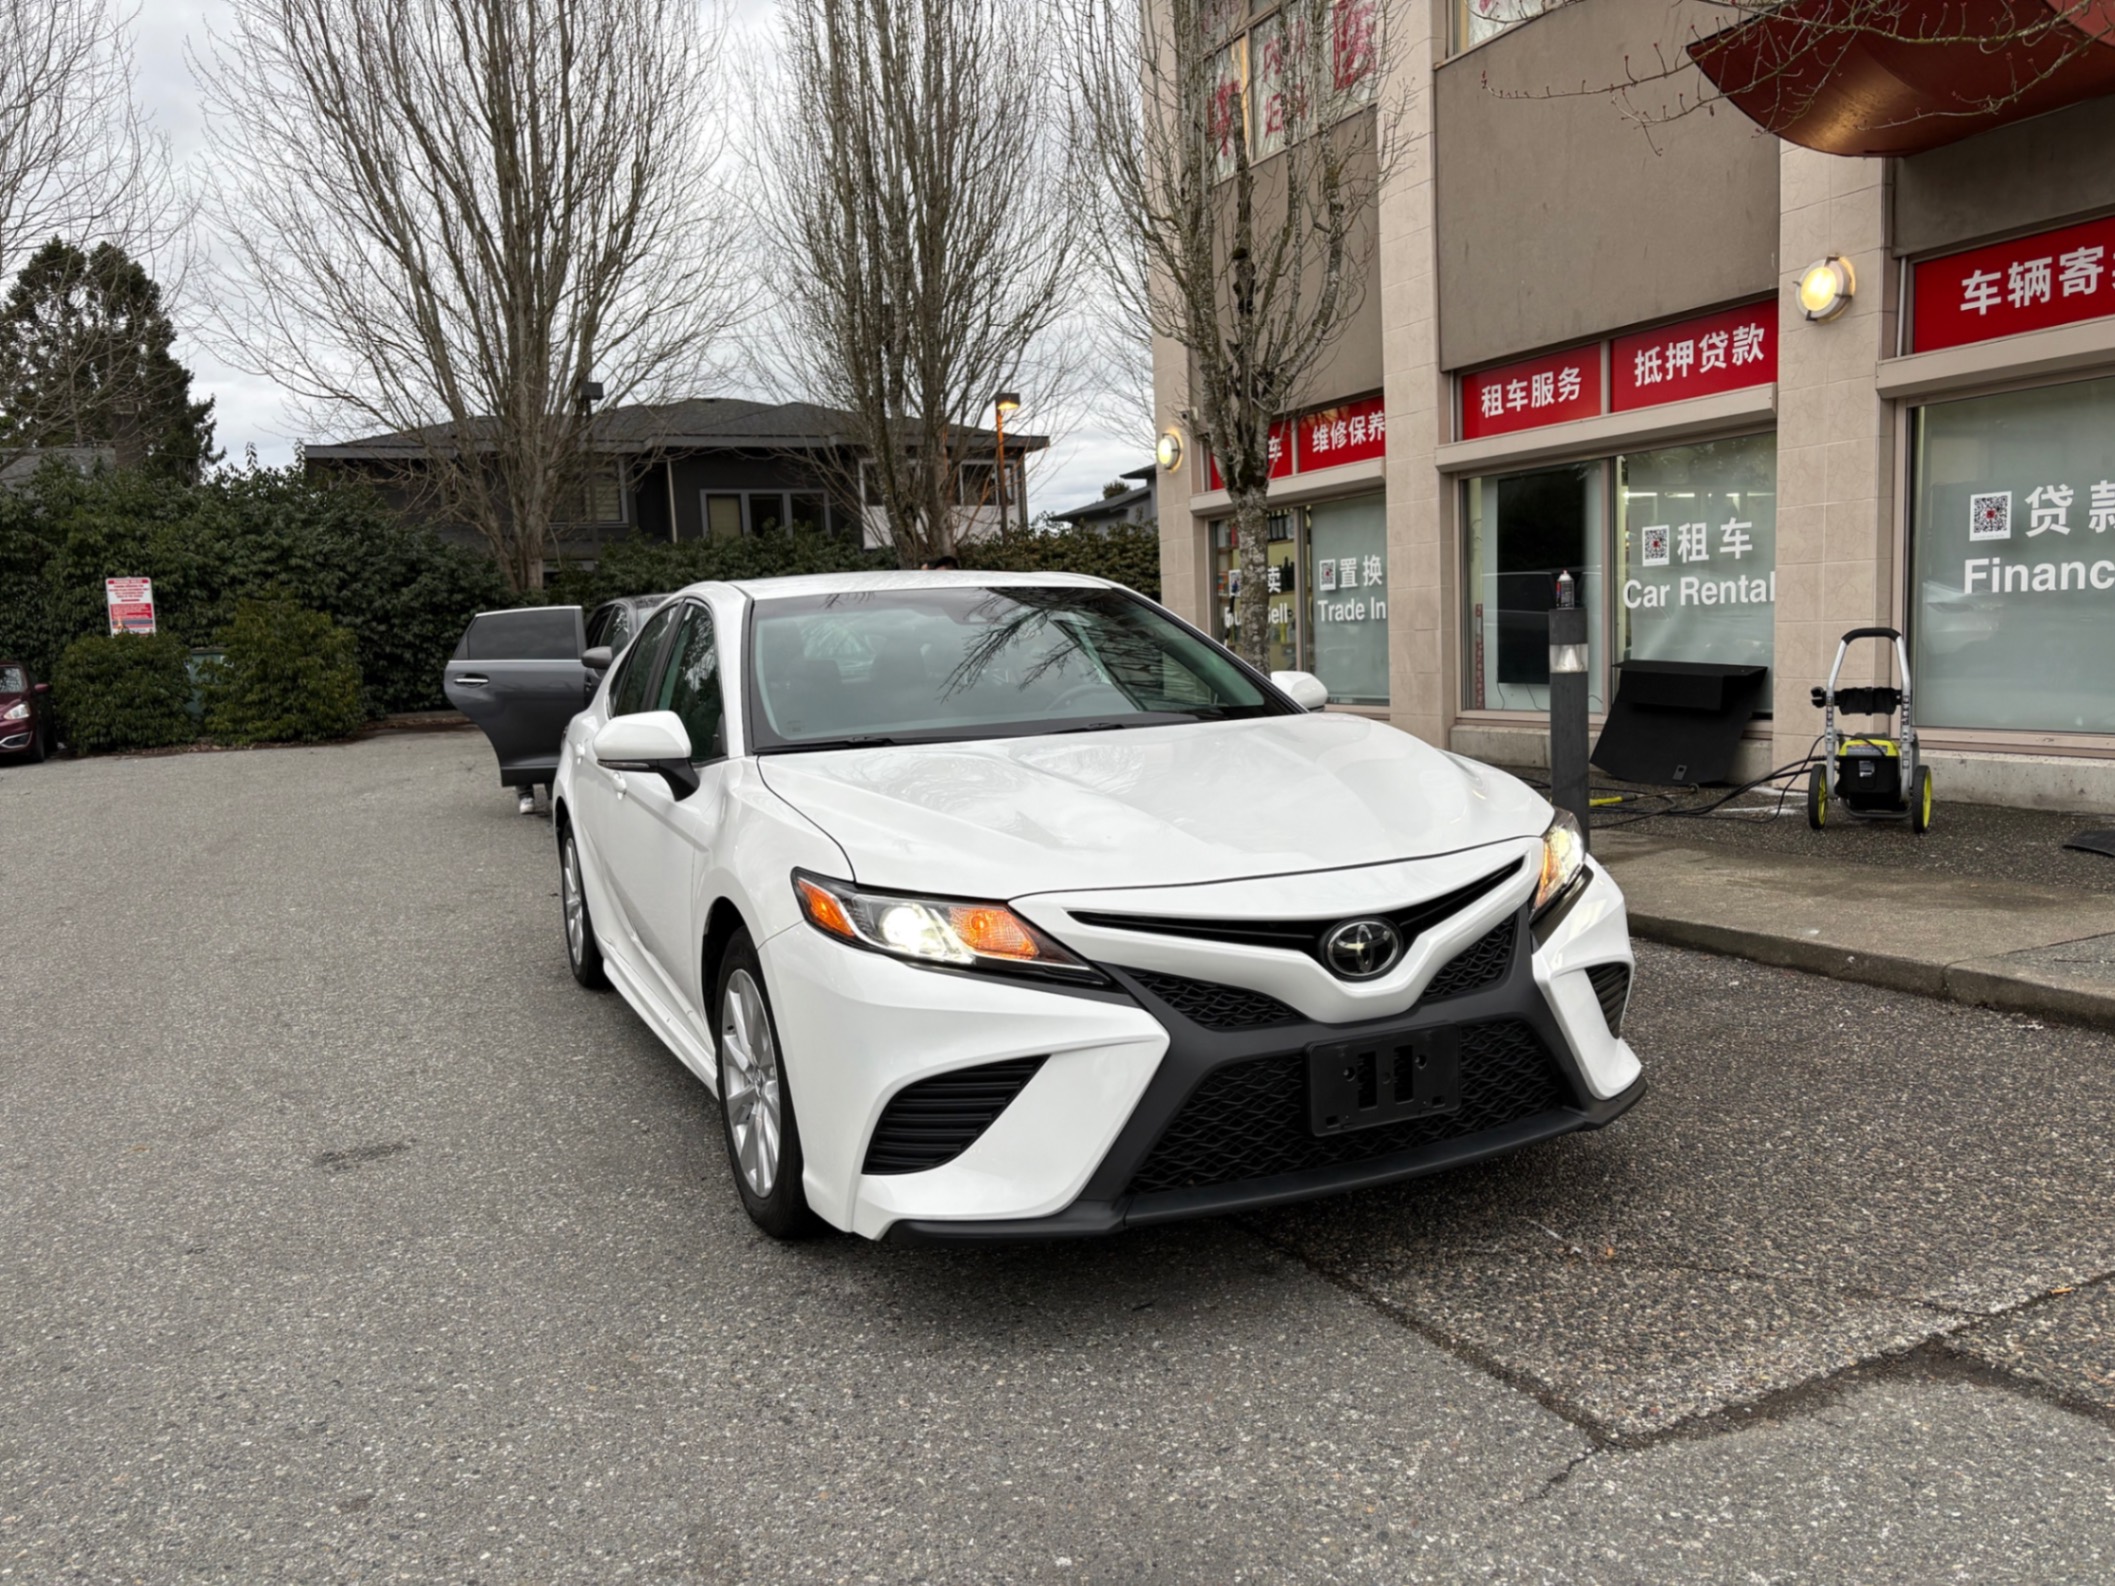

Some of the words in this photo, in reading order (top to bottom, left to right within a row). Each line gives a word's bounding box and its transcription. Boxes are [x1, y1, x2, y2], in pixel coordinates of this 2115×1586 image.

[1960, 245, 2115, 316] 车辆寄
[1634, 322, 1766, 387] 抵押贷款
[1481, 366, 1582, 418] 租车服务
[1312, 410, 1386, 453] 维修保养
[1677, 517, 1753, 563] 租车
[1339, 554, 1383, 588] 置换
[1623, 579, 1670, 609] Car
[1680, 571, 1775, 606] Rental
[1268, 603, 1288, 624] ell
[1317, 598, 1365, 622] Trade
[1371, 597, 1386, 620] In
